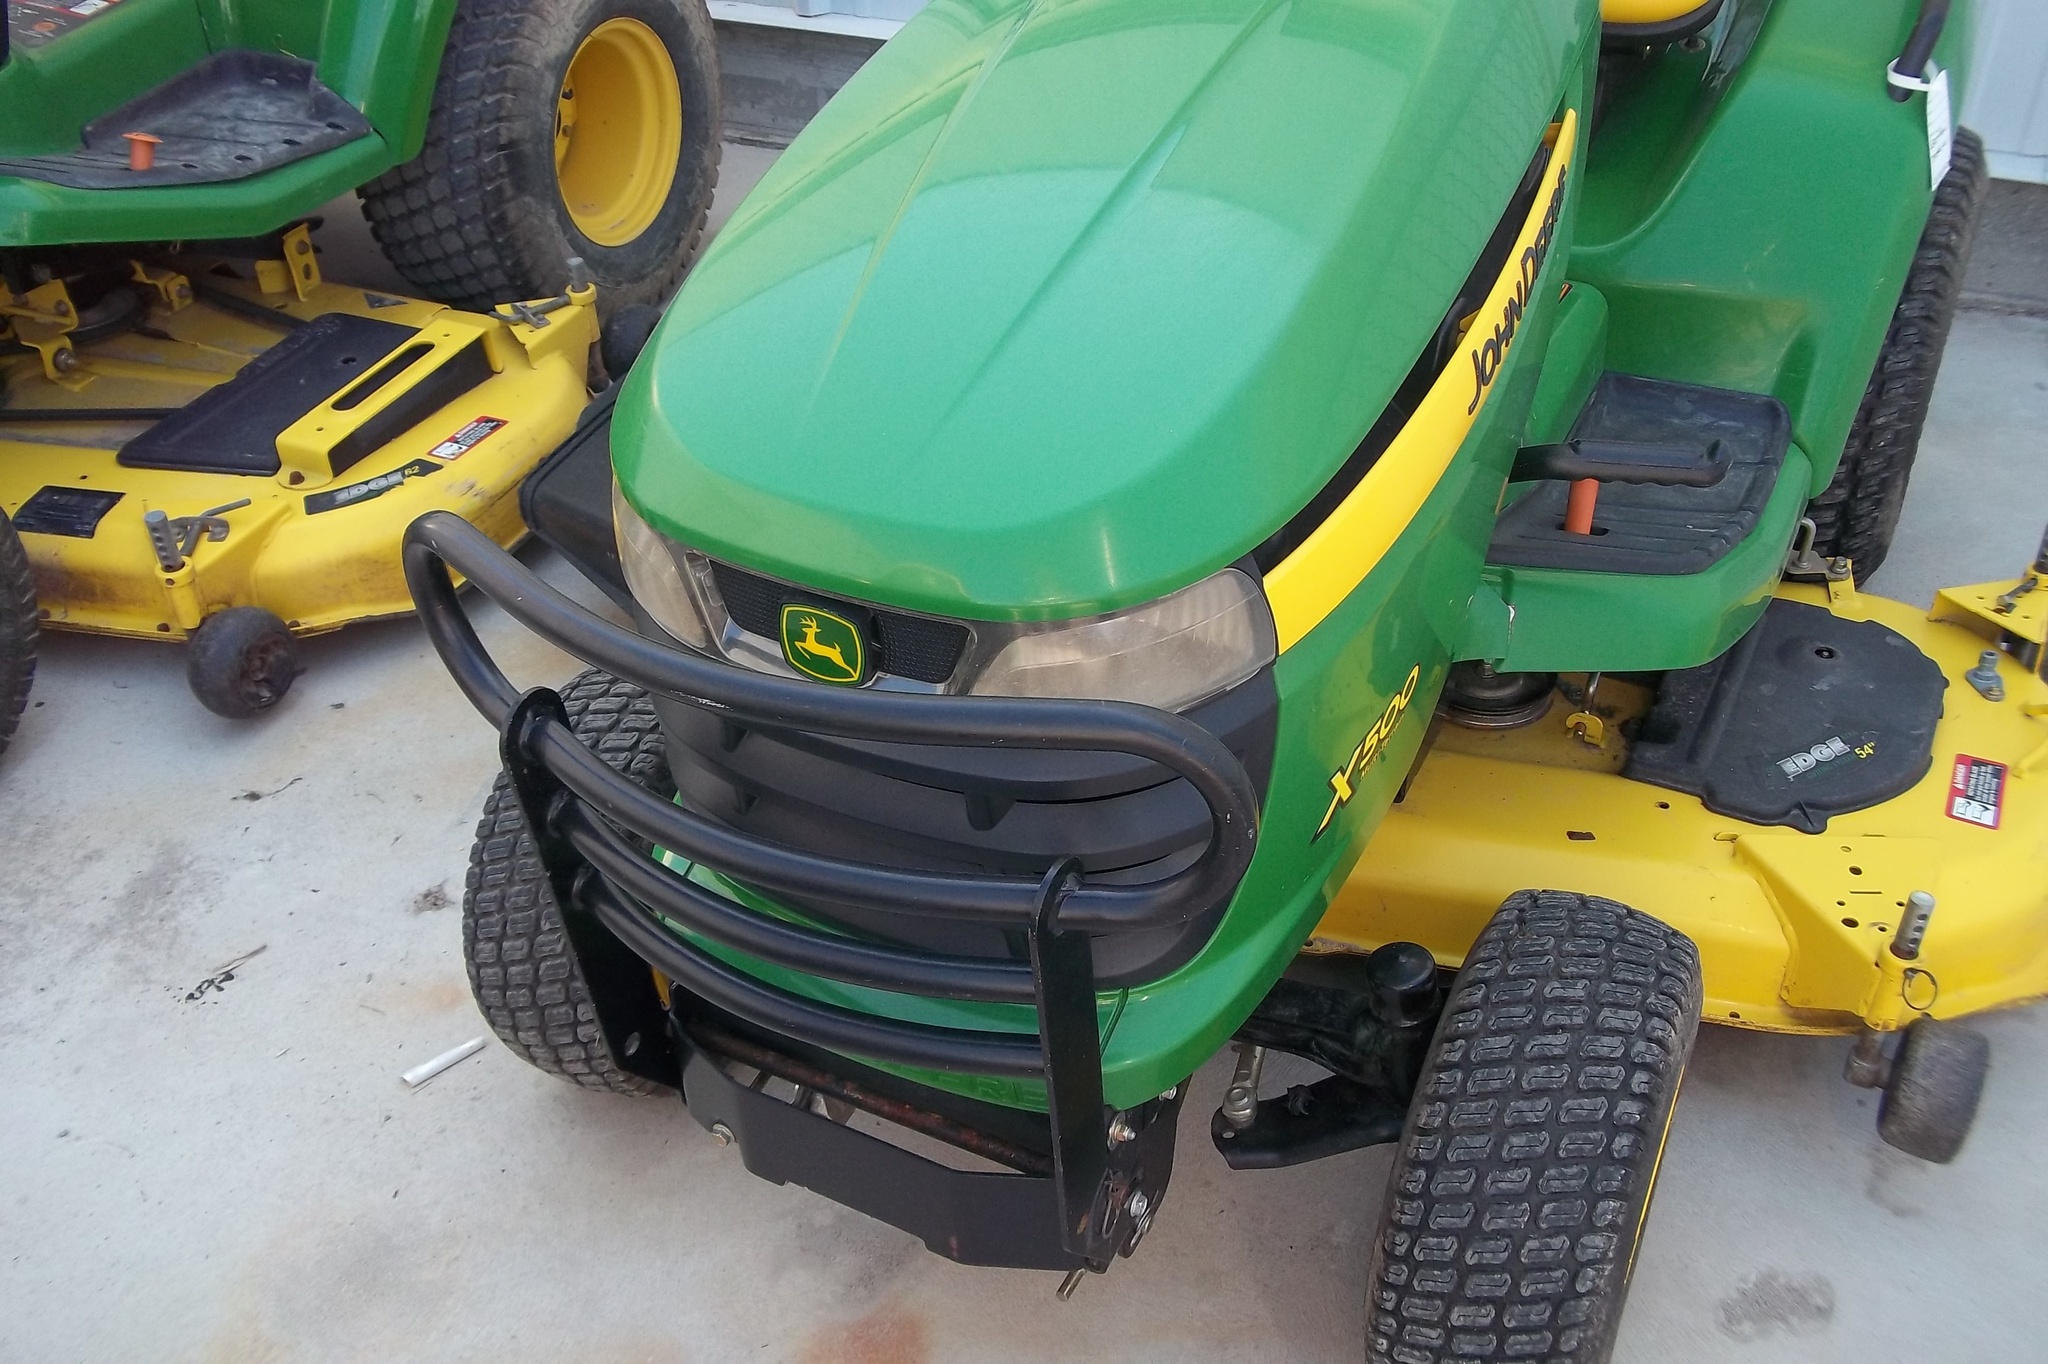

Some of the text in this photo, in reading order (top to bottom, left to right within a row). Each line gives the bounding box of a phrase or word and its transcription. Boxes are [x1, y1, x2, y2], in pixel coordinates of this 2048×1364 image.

[1467, 280, 1523, 416] JOHN
[404, 465, 420, 476] 62
[1312, 662, 1421, 843] X500
[1775, 736, 1851, 781] EDGE
[1854, 741, 1876, 759] 54"
